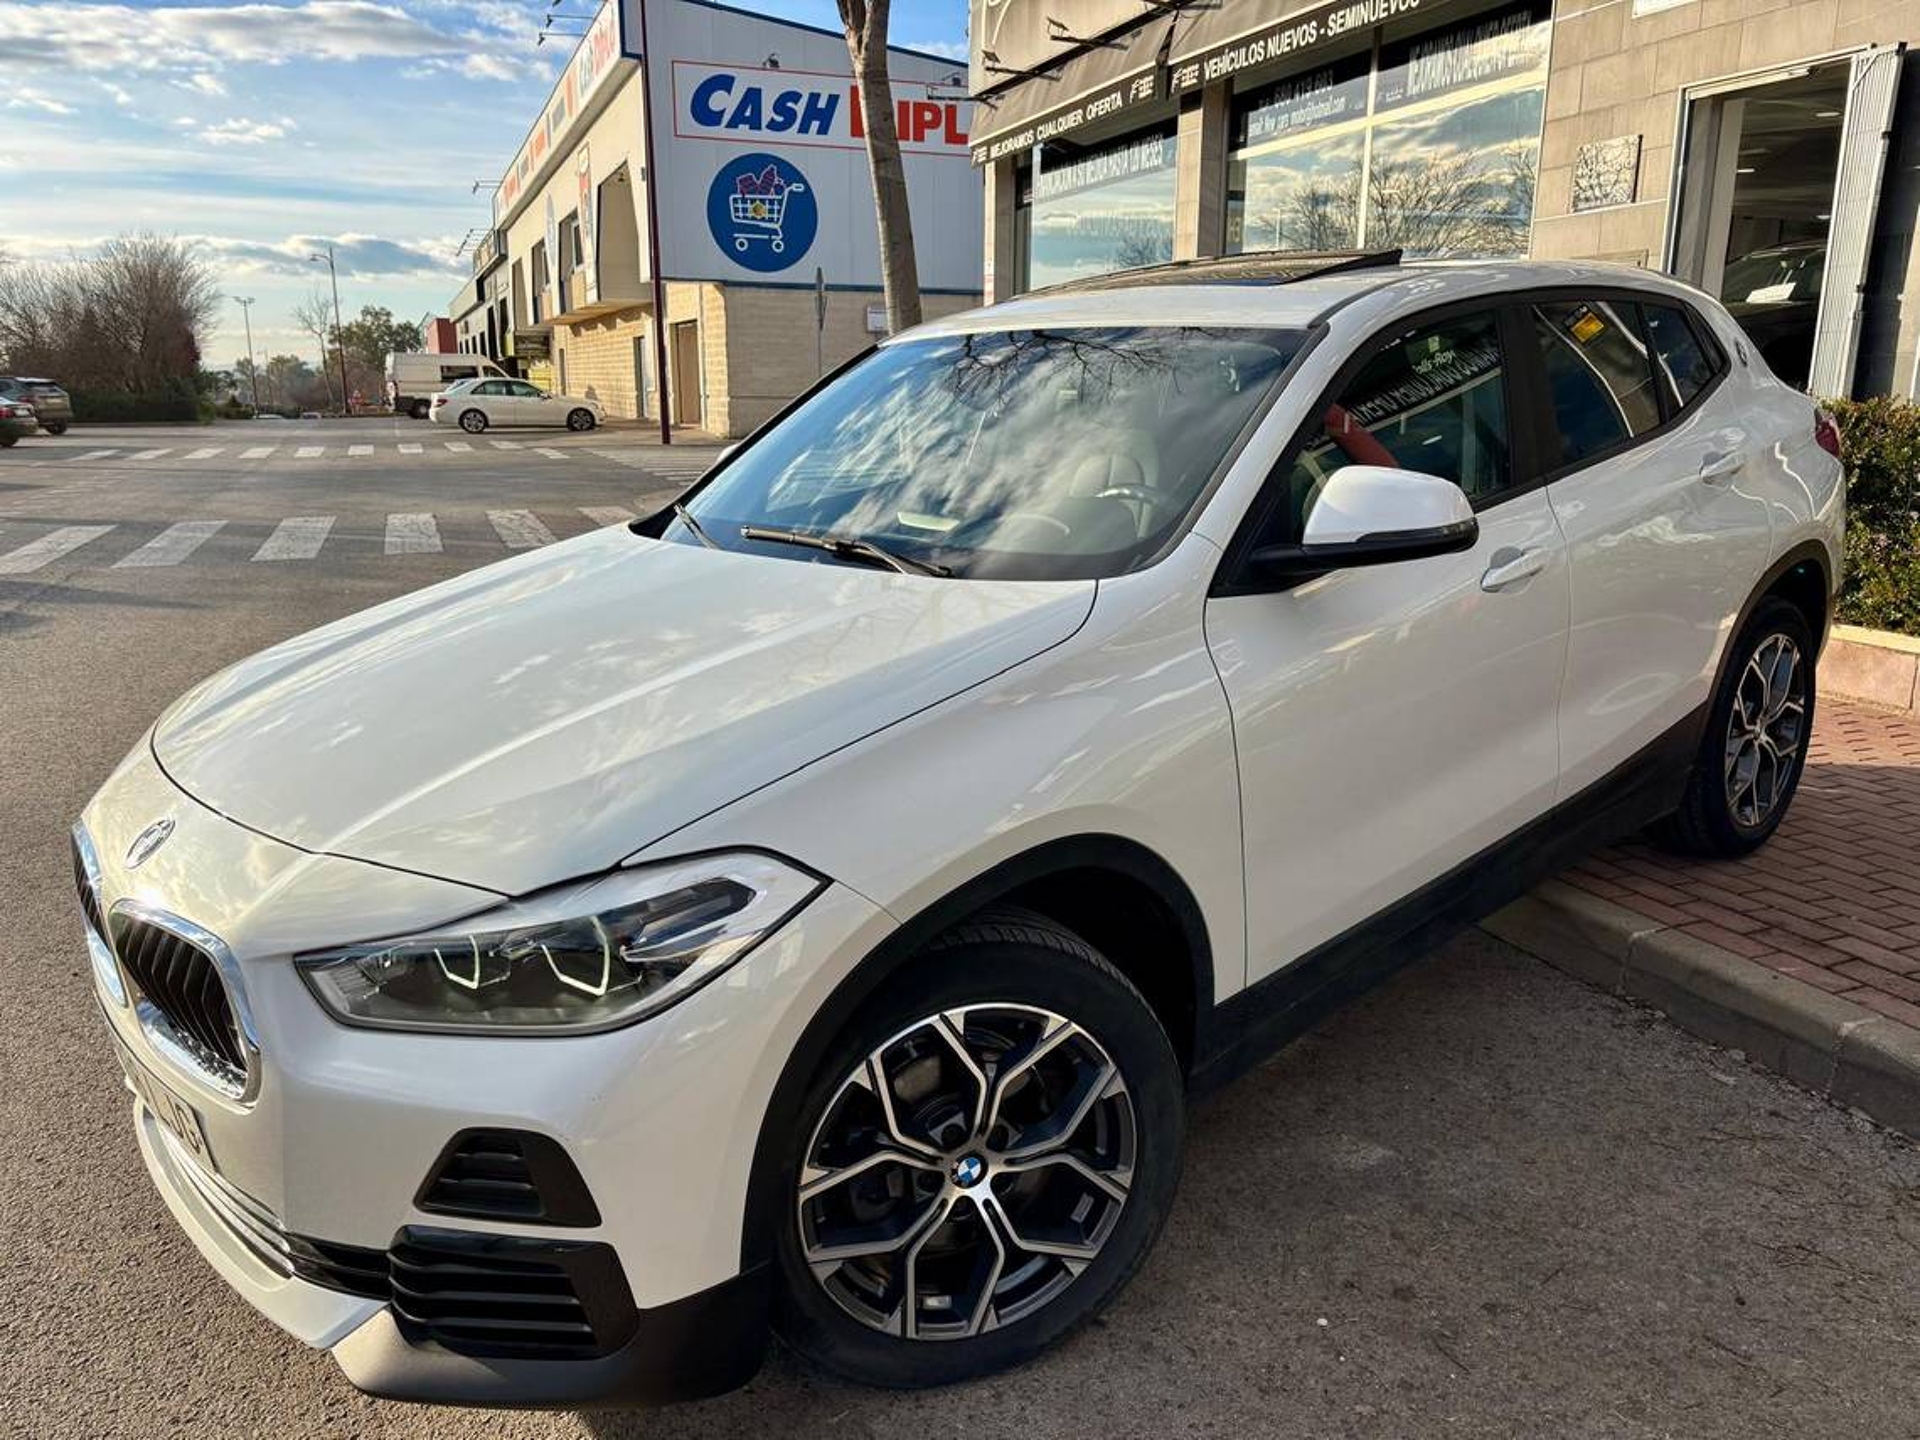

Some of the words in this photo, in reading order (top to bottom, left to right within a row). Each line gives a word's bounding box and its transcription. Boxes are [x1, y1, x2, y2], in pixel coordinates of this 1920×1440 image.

[1203, 41, 1265, 81] VEHÍCULOS
[1266, 20, 1317, 58] NUEVOS
[690, 74, 840, 135] CASH
[1037, 109, 1084, 140] CUALQUIER
[1086, 90, 1123, 121] OFERTA
